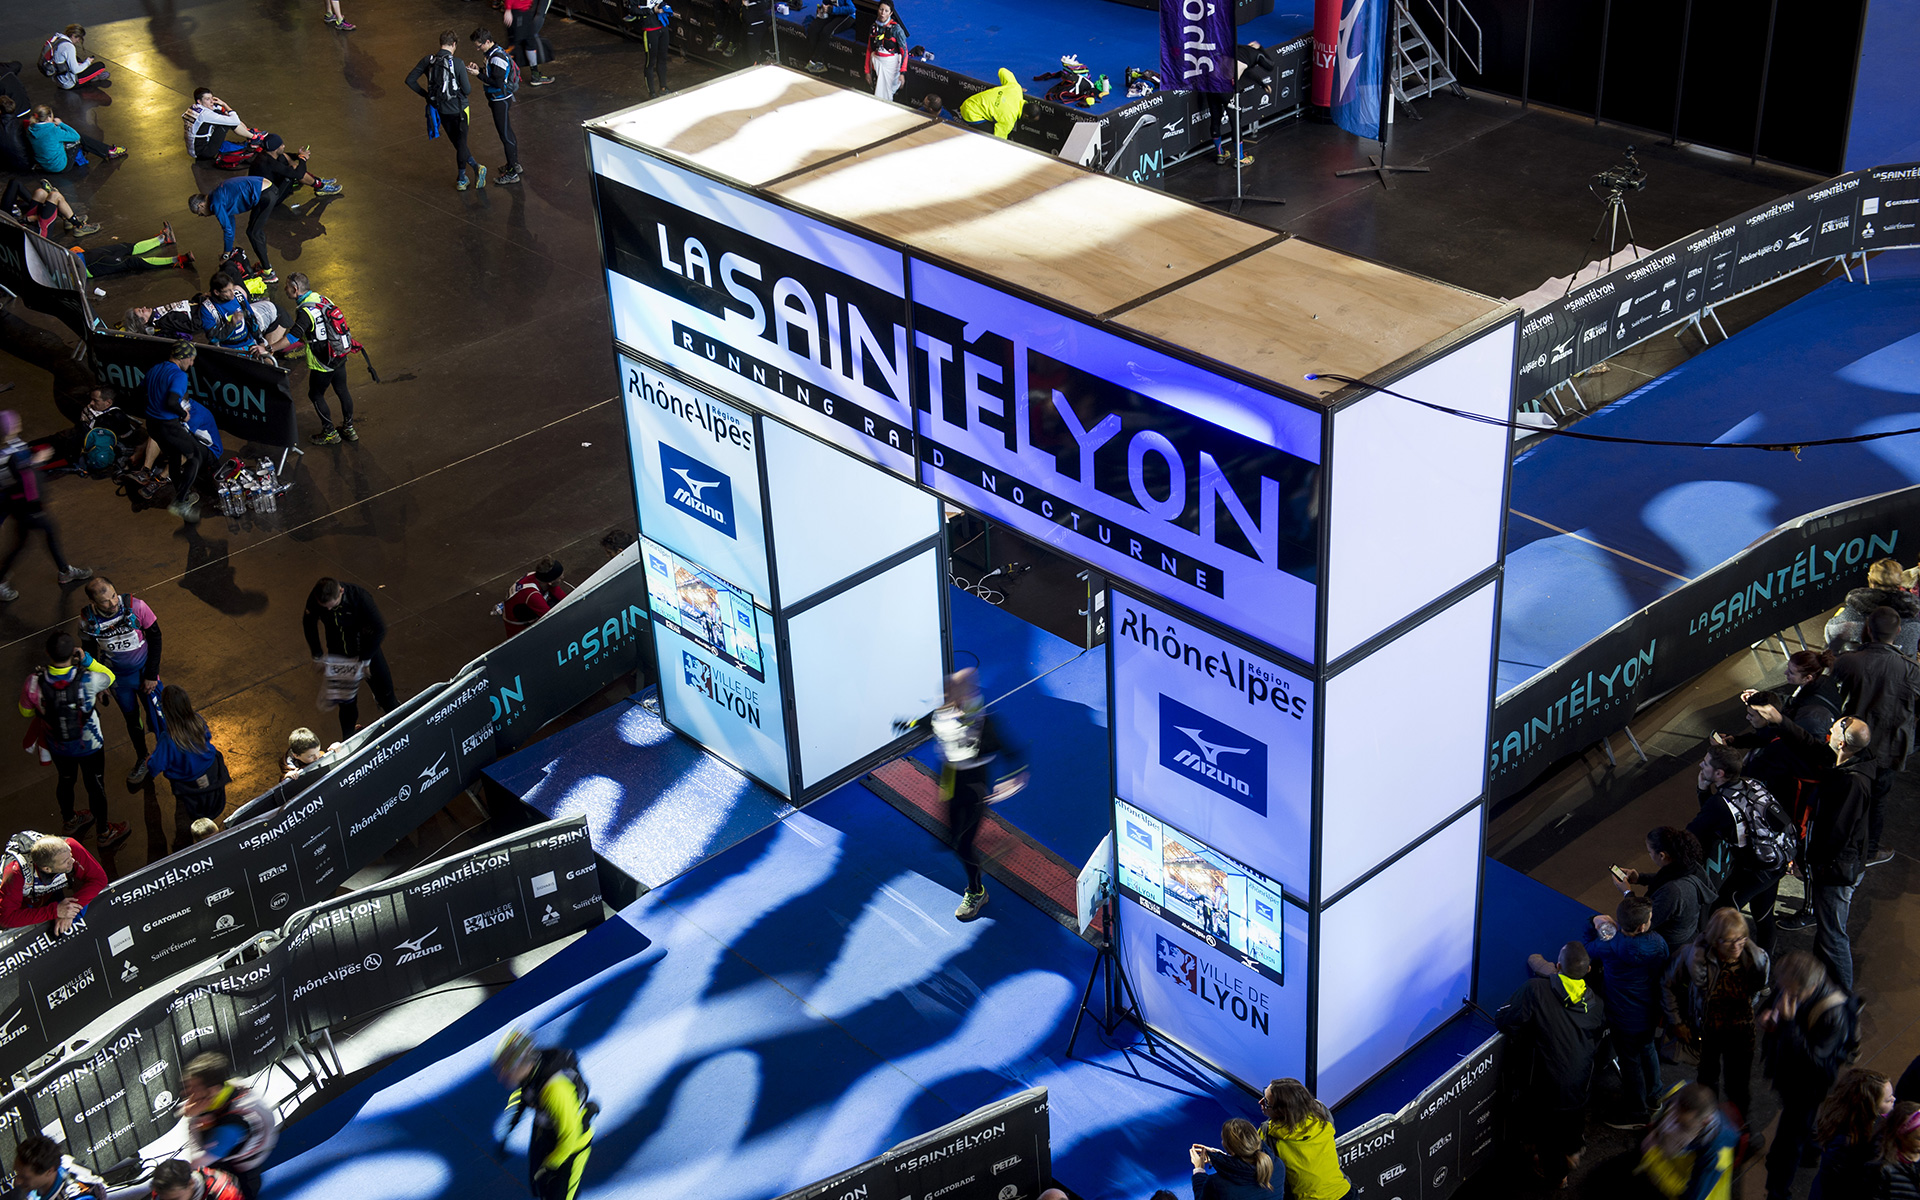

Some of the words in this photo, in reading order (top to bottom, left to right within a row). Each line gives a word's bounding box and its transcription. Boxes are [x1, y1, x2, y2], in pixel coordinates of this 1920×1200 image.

[711, 405, 741, 426] Région
[982, 472, 1207, 590] NOCTURNE
[1708, 607, 1762, 645] RUNNING
[1772, 589, 1805, 609] RAID
[1816, 562, 1869, 592] NOCTUR
[107, 639, 131, 651] 975
[711, 667, 742, 693] VILLE
[744, 686, 759, 706] DE
[1247, 662, 1290, 690] Région
[714, 682, 761, 730] LYON
[152, 907, 192, 928] GATORADE
[484, 909, 515, 928] LYON
[66, 973, 96, 998] LYON
[1200, 958, 1243, 995] VILLE
[1248, 986, 1270, 1011] DE
[1201, 976, 1270, 1036] LYON
[992, 1155, 1022, 1176] PETZL
[1379, 1164, 1407, 1187] PETZL
[934, 1175, 976, 1198] GATORADE
